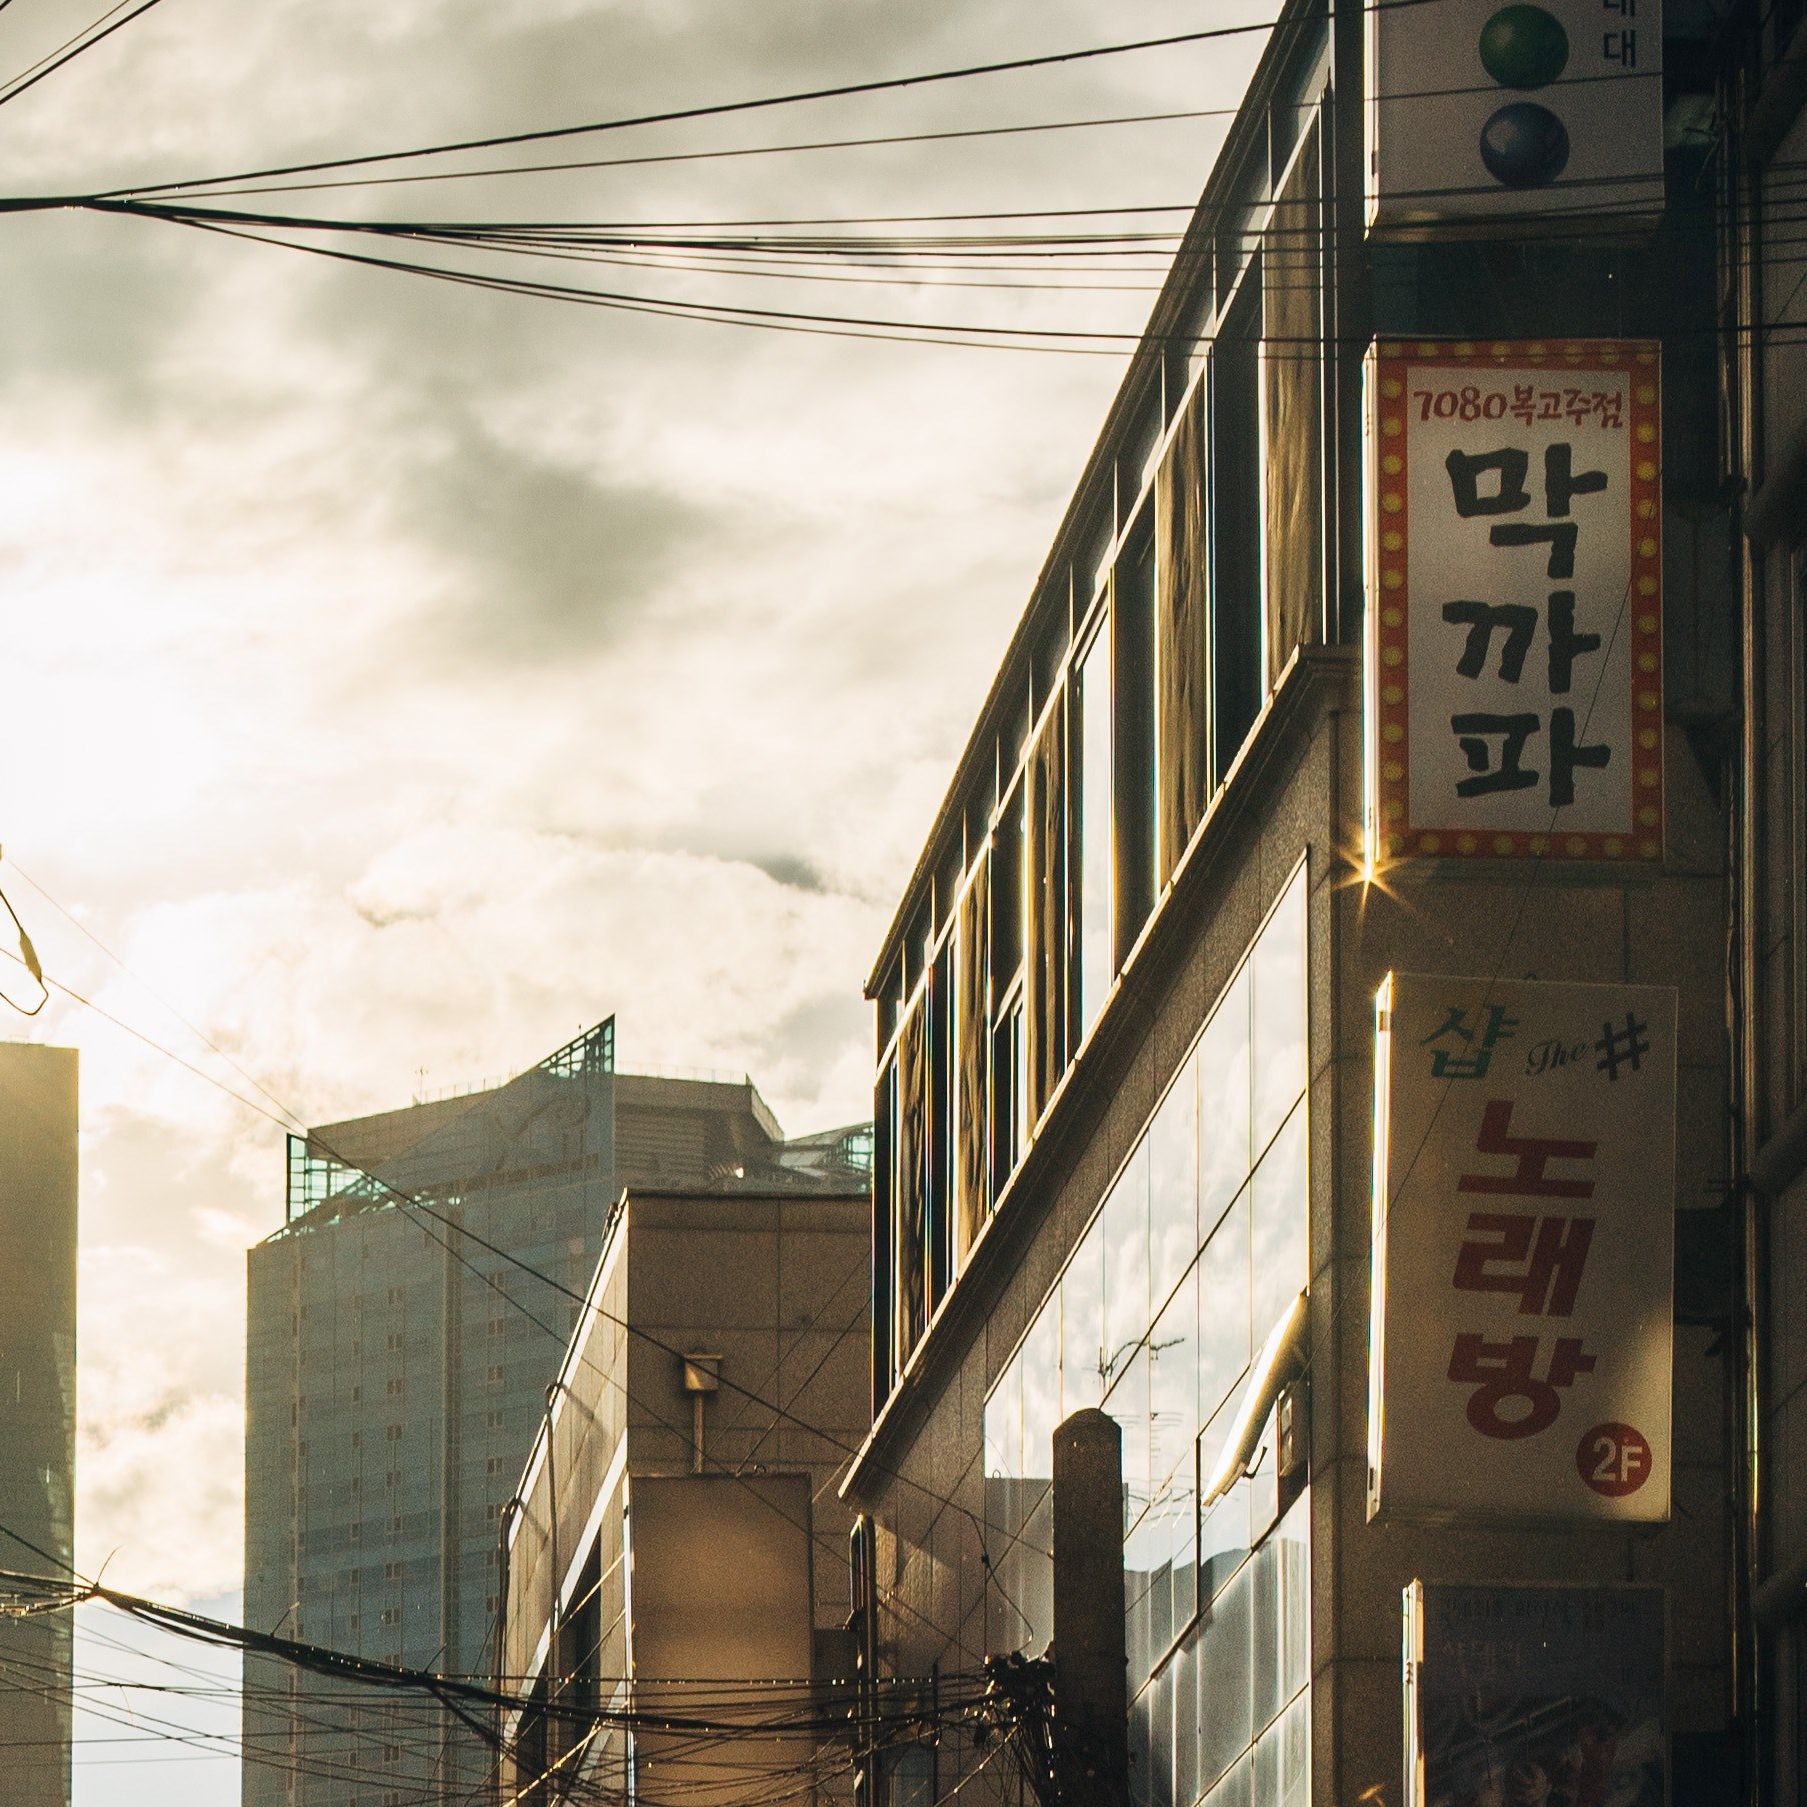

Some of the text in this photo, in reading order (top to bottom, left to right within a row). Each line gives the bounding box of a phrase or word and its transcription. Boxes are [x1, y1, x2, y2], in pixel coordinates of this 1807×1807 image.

[1413, 385, 1623, 429] 7080복고주점
[1443, 442, 1611, 807] 막까파
[1421, 1003, 1519, 1080] 샵
[1525, 1039, 1589, 1076] The
[1448, 1099, 1598, 1440] 노래방
[1591, 1436, 1645, 1484] 2F
